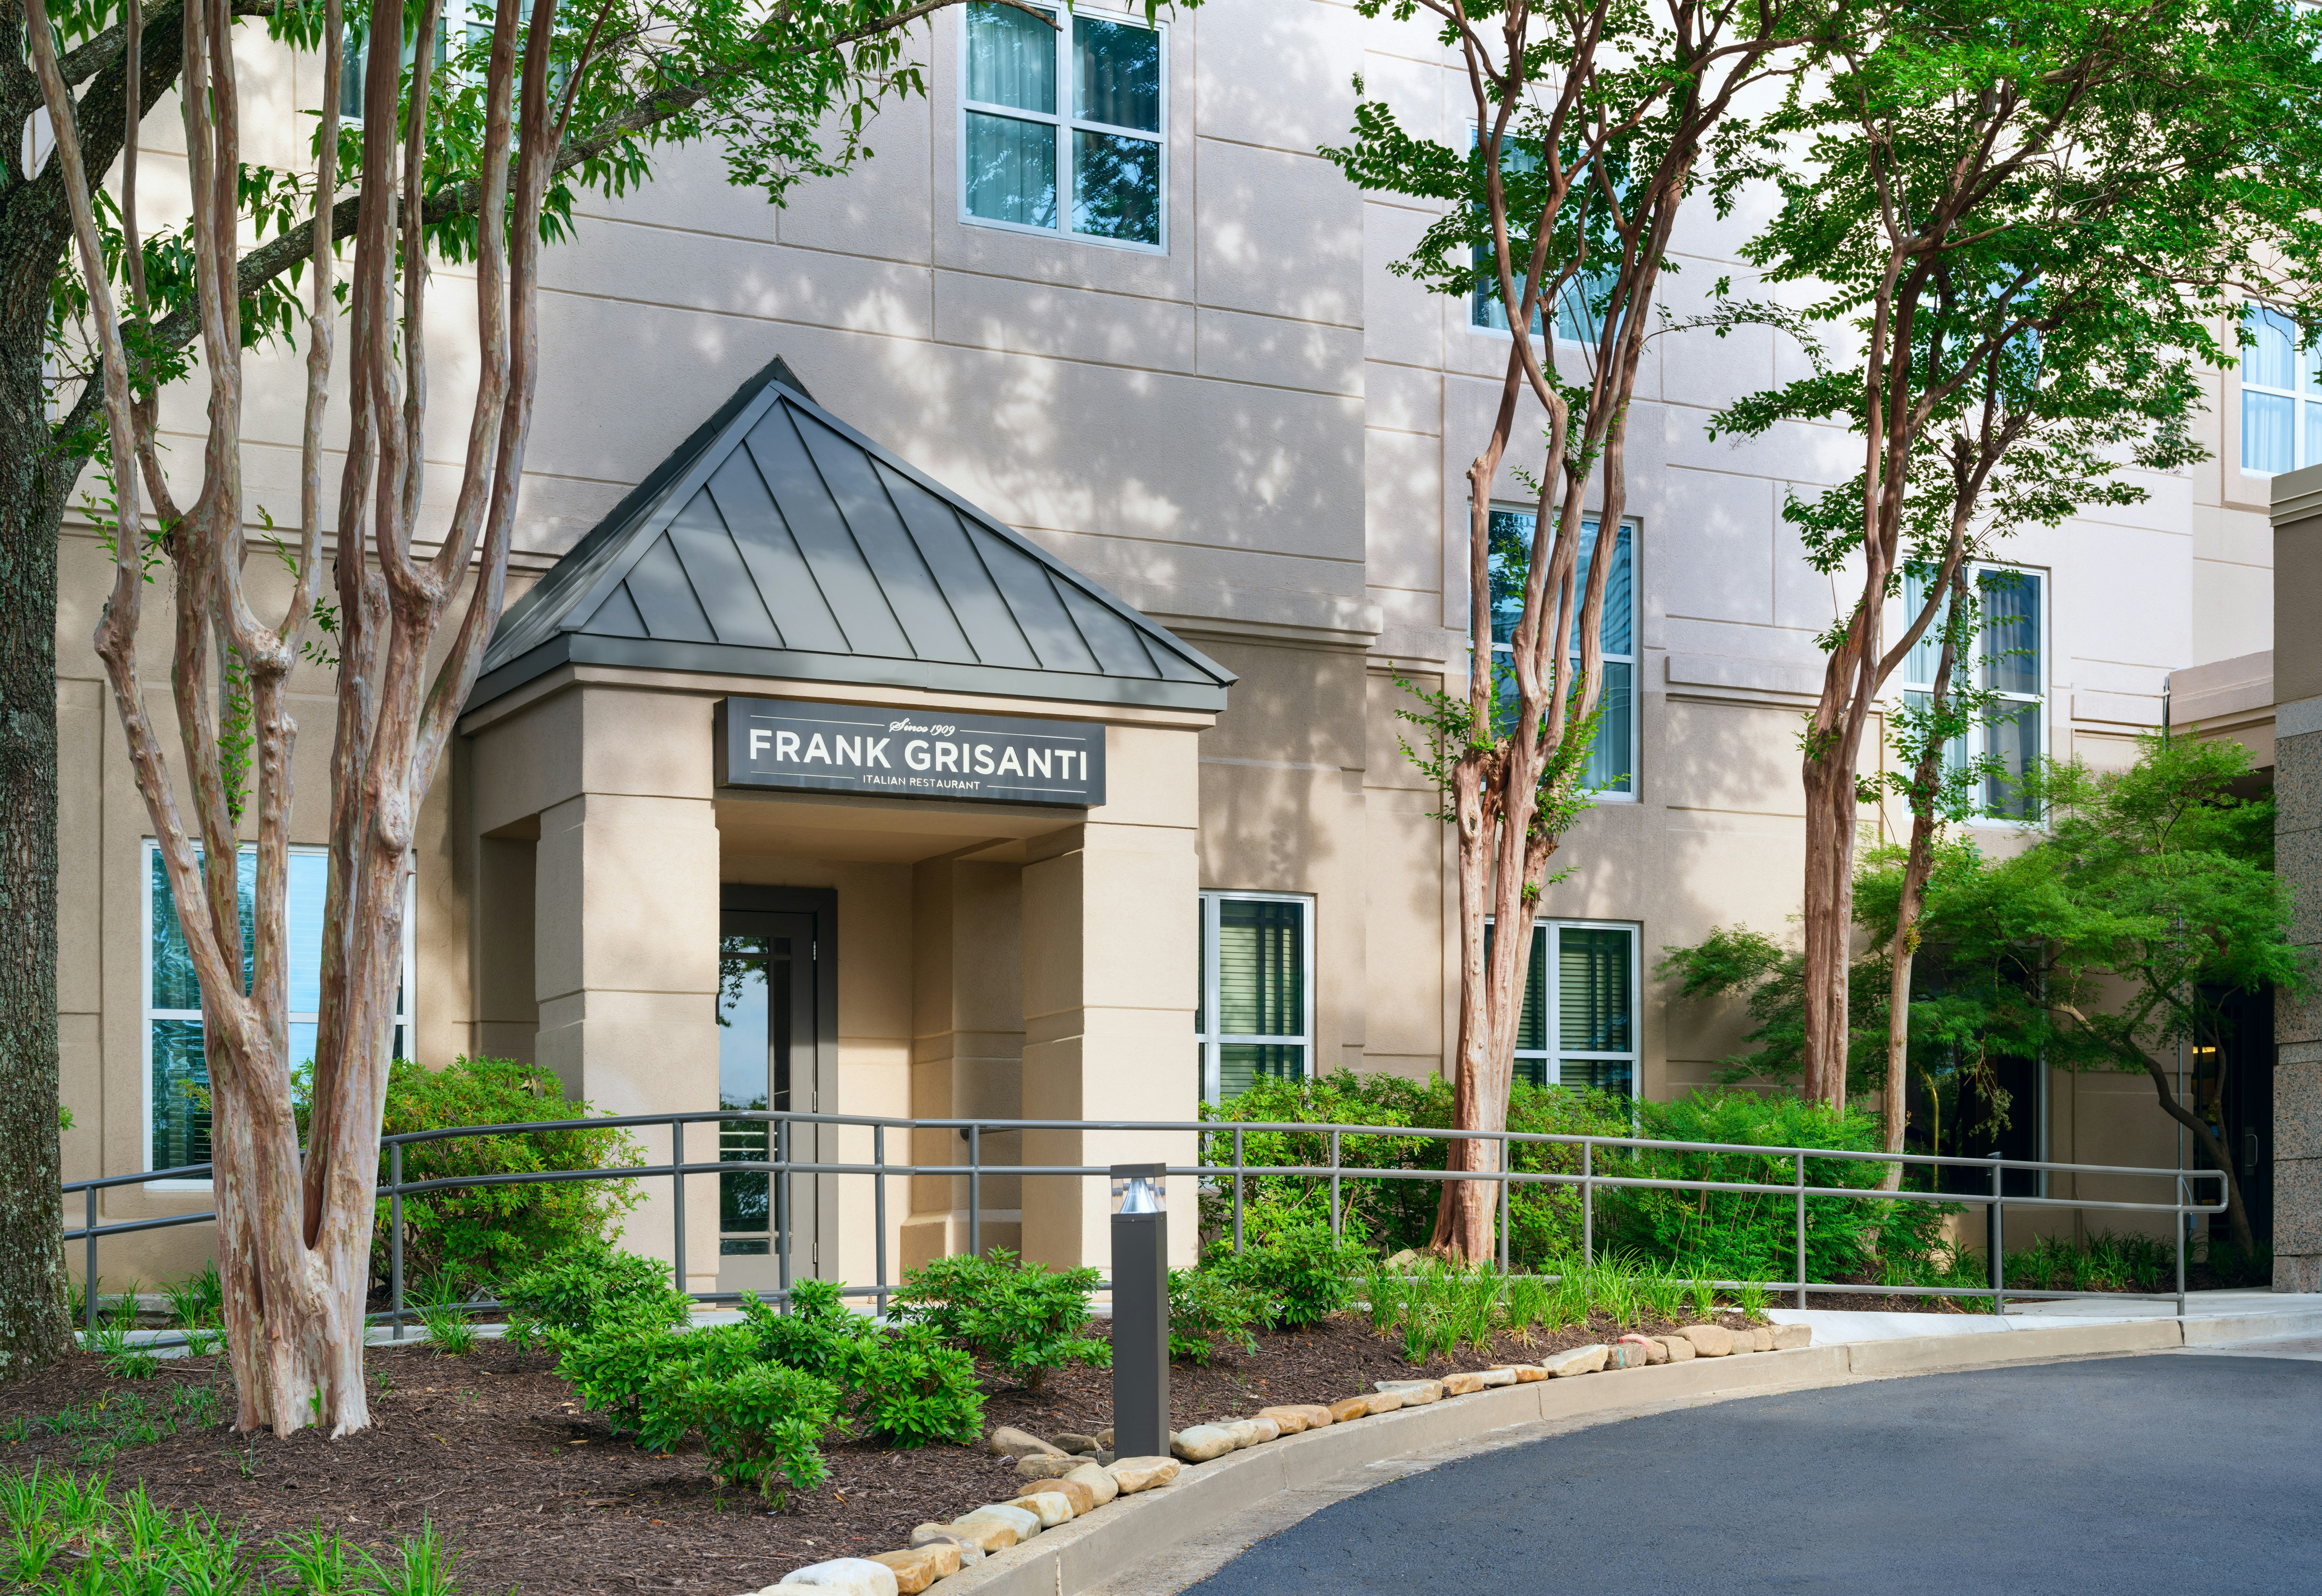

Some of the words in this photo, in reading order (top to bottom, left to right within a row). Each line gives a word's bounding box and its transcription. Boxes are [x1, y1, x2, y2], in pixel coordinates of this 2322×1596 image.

[889, 717, 928, 733] Since
[930, 724, 956, 737] 1909
[750, 728, 892, 768] FRANK
[904, 739, 1087, 781] GRISANTI
[863, 775, 906, 785] ITALIAN
[909, 777, 981, 790] RESTAURANT
